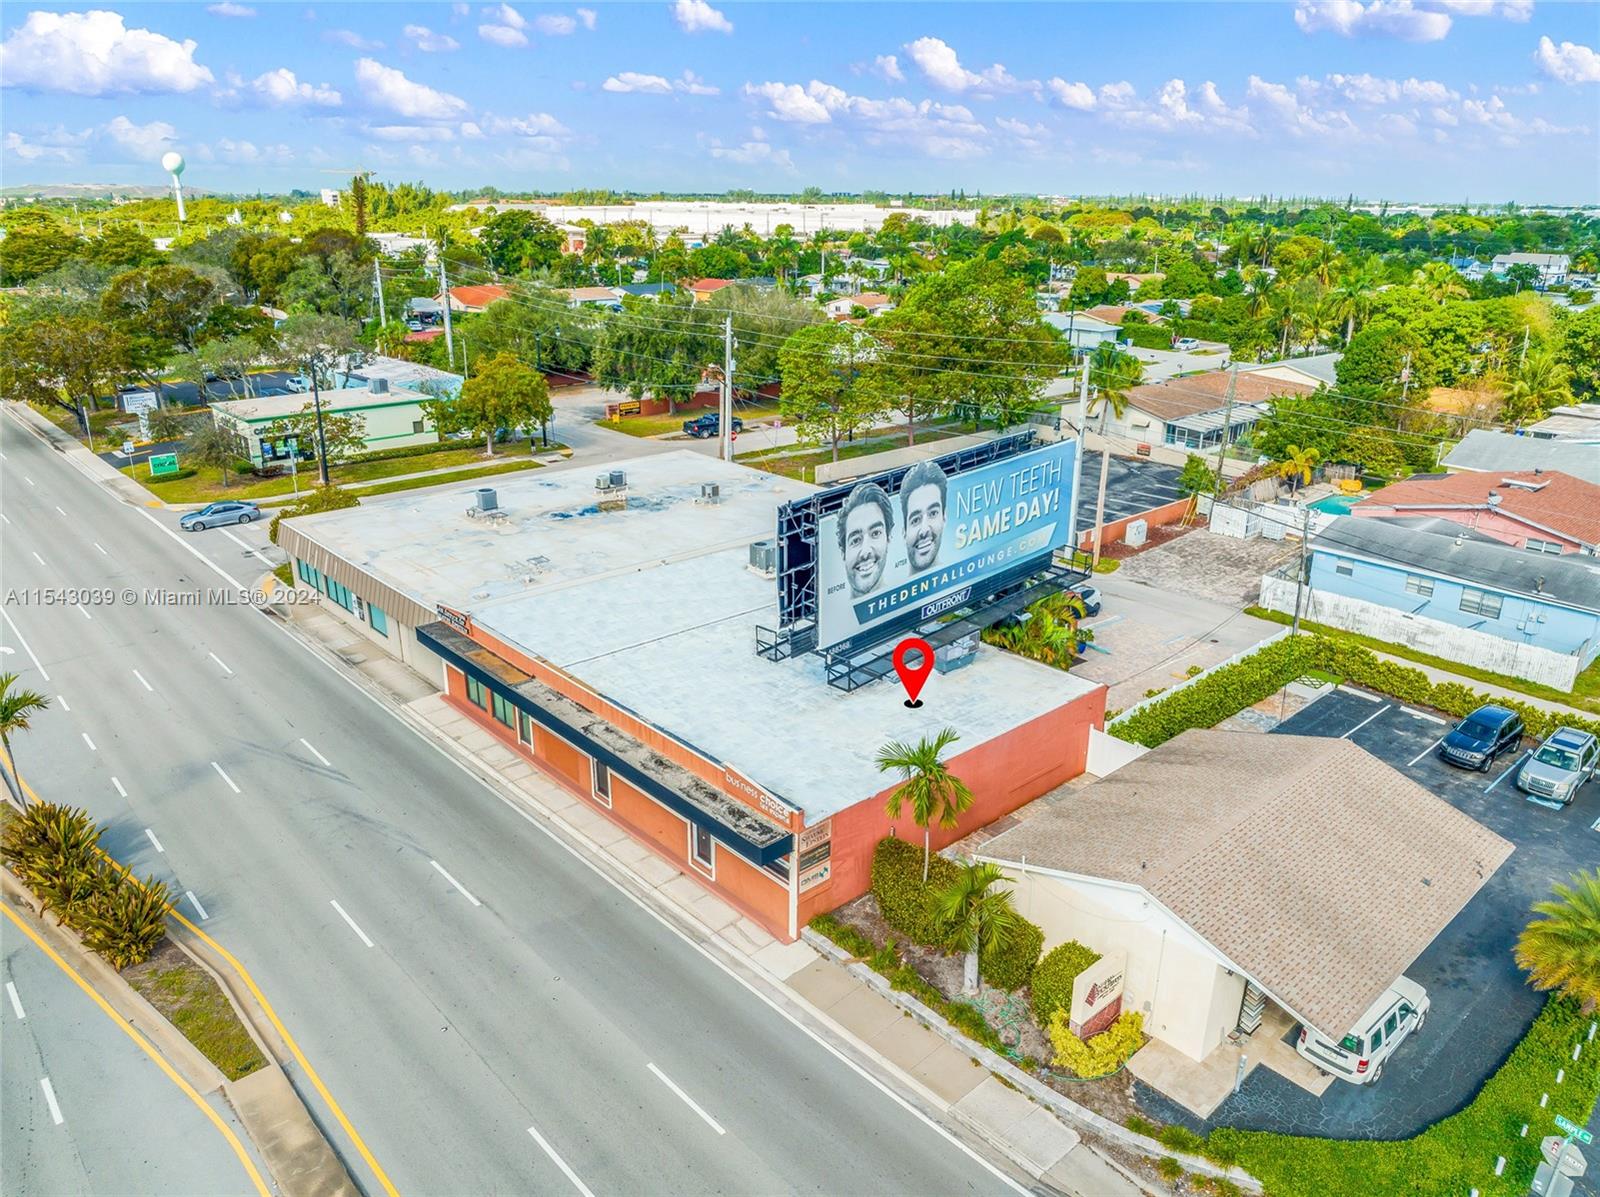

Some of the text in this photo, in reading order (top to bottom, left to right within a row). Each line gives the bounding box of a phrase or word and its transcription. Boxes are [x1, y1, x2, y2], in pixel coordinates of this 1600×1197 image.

[956, 457, 1062, 519] NEW TEETH
[955, 487, 1060, 550] SAME DAY!
[867, 533, 1048, 615] THEDENTALLOUNGE.COM
[894, 558, 908, 569] AFTER
[827, 582, 846, 595] BEFORE
[926, 590, 967, 616] OUTFRONT
[760, 794, 790, 818] choice
[1557, 1116, 1582, 1136] SAMPLE
